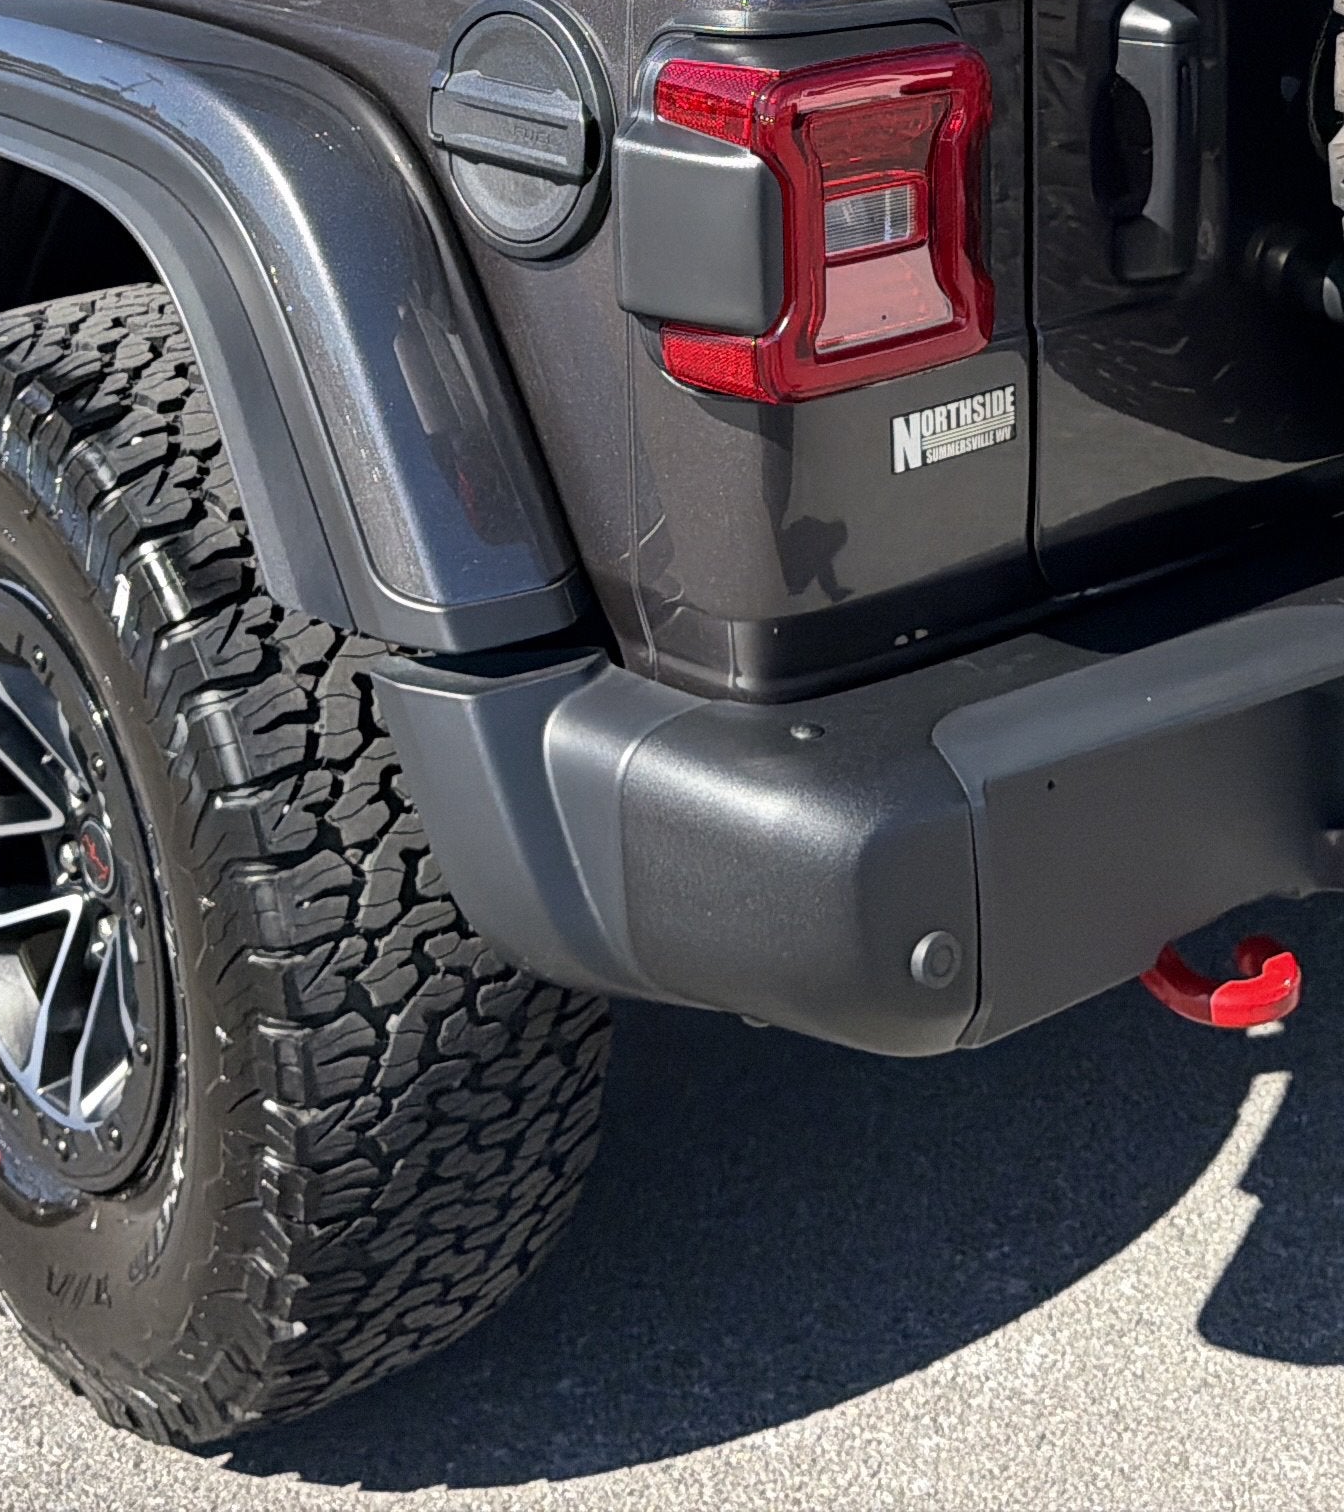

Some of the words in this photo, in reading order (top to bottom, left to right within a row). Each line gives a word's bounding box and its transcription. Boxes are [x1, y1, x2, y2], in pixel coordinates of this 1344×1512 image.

[892, 385, 1016, 474] NORTHSIDE
[925, 431, 996, 465] SUMMERSVILLE
[995, 425, 1013, 444] WV
